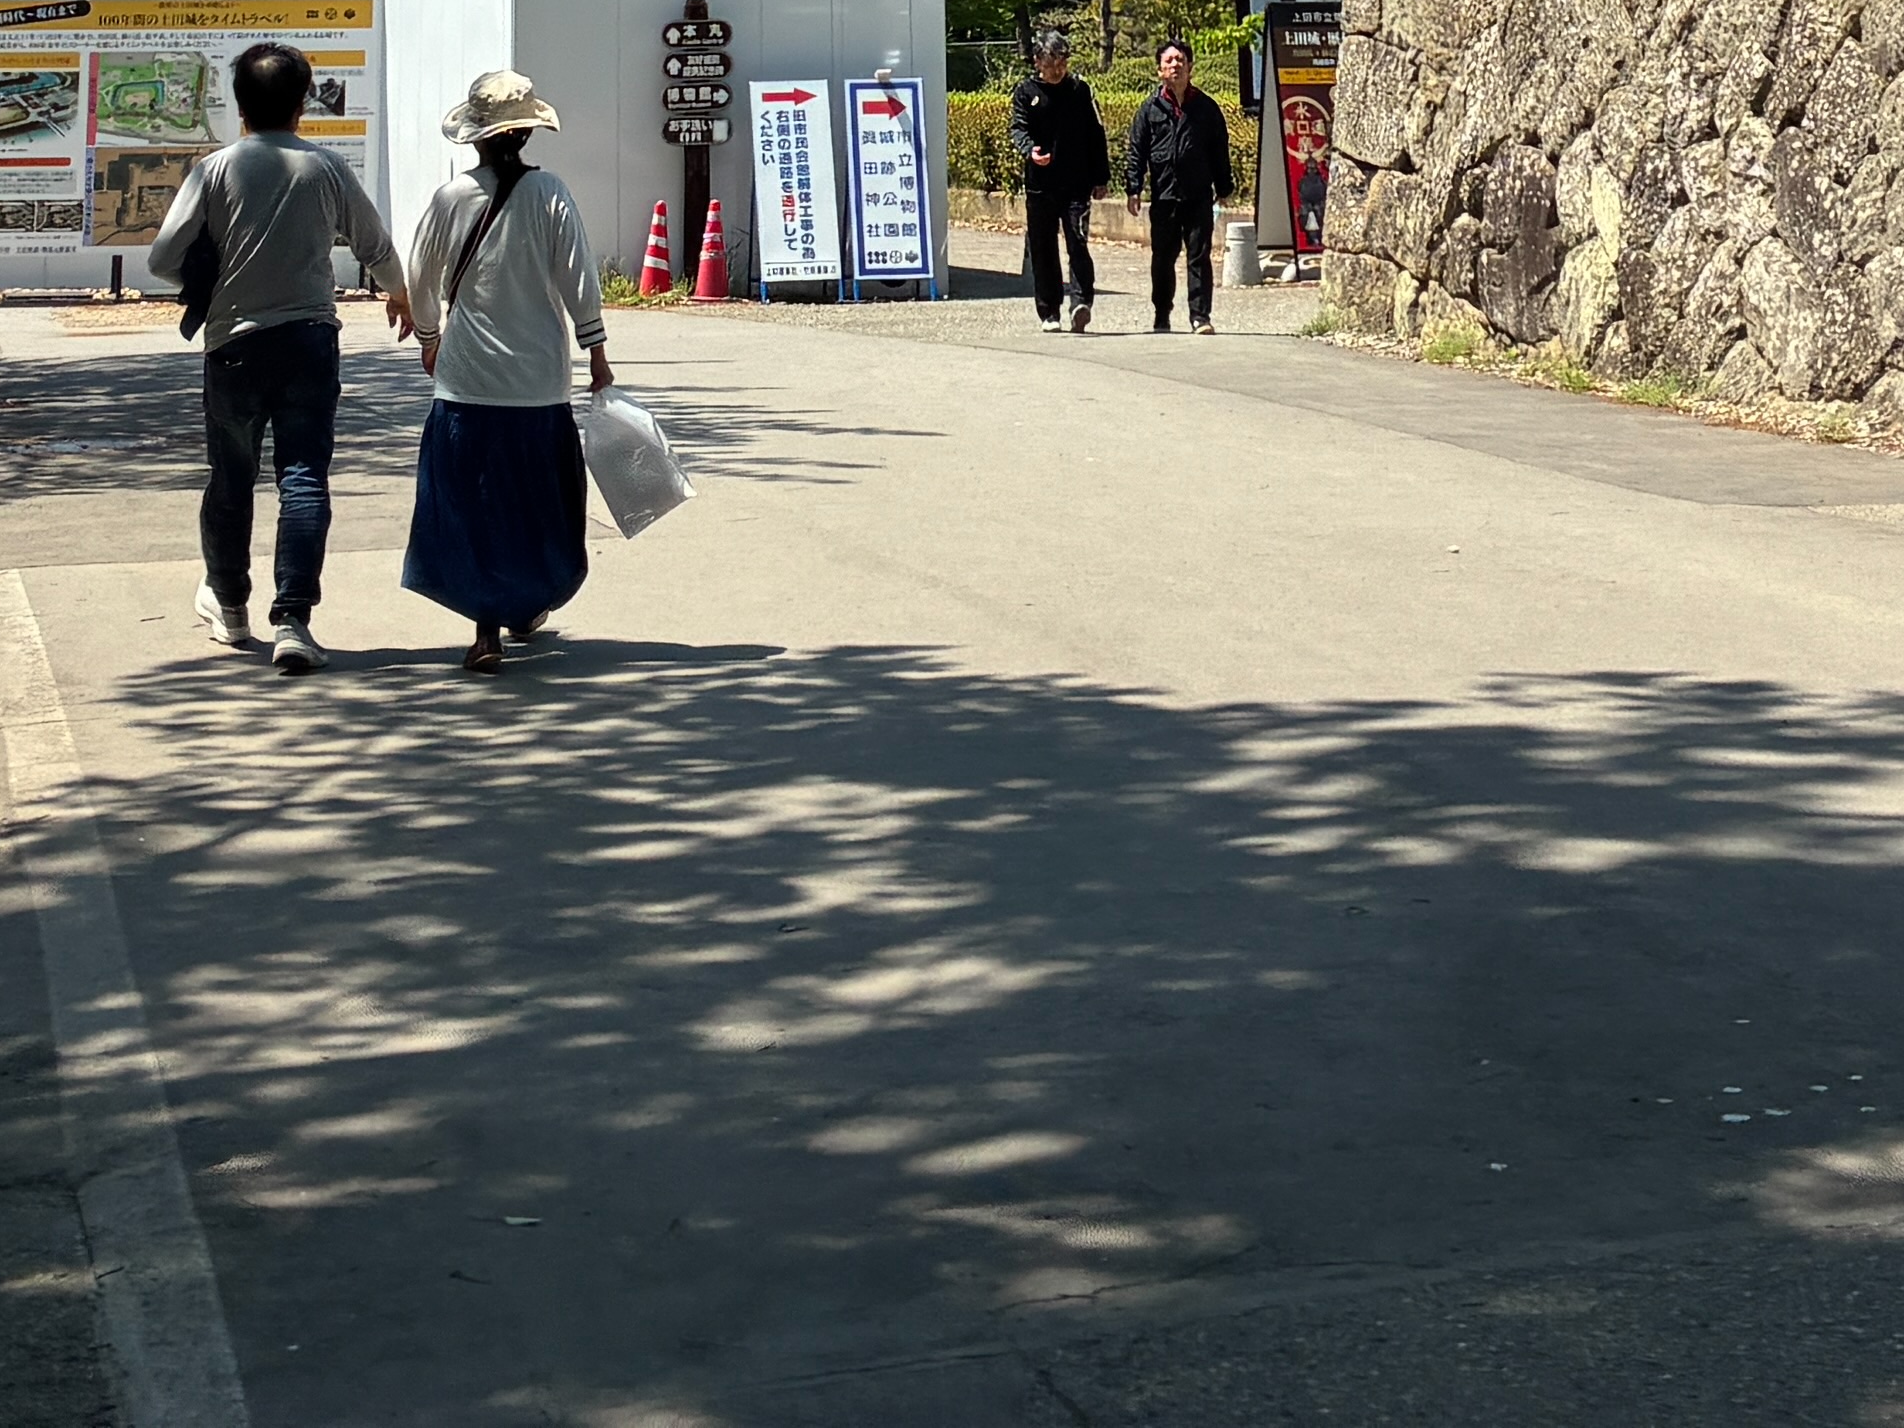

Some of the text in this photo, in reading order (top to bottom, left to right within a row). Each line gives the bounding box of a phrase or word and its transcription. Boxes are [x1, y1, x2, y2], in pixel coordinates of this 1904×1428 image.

[760, 110, 776, 166] ください
[879, 131, 899, 237] 城跡公園
[897, 131, 917, 237] 市立博物館
